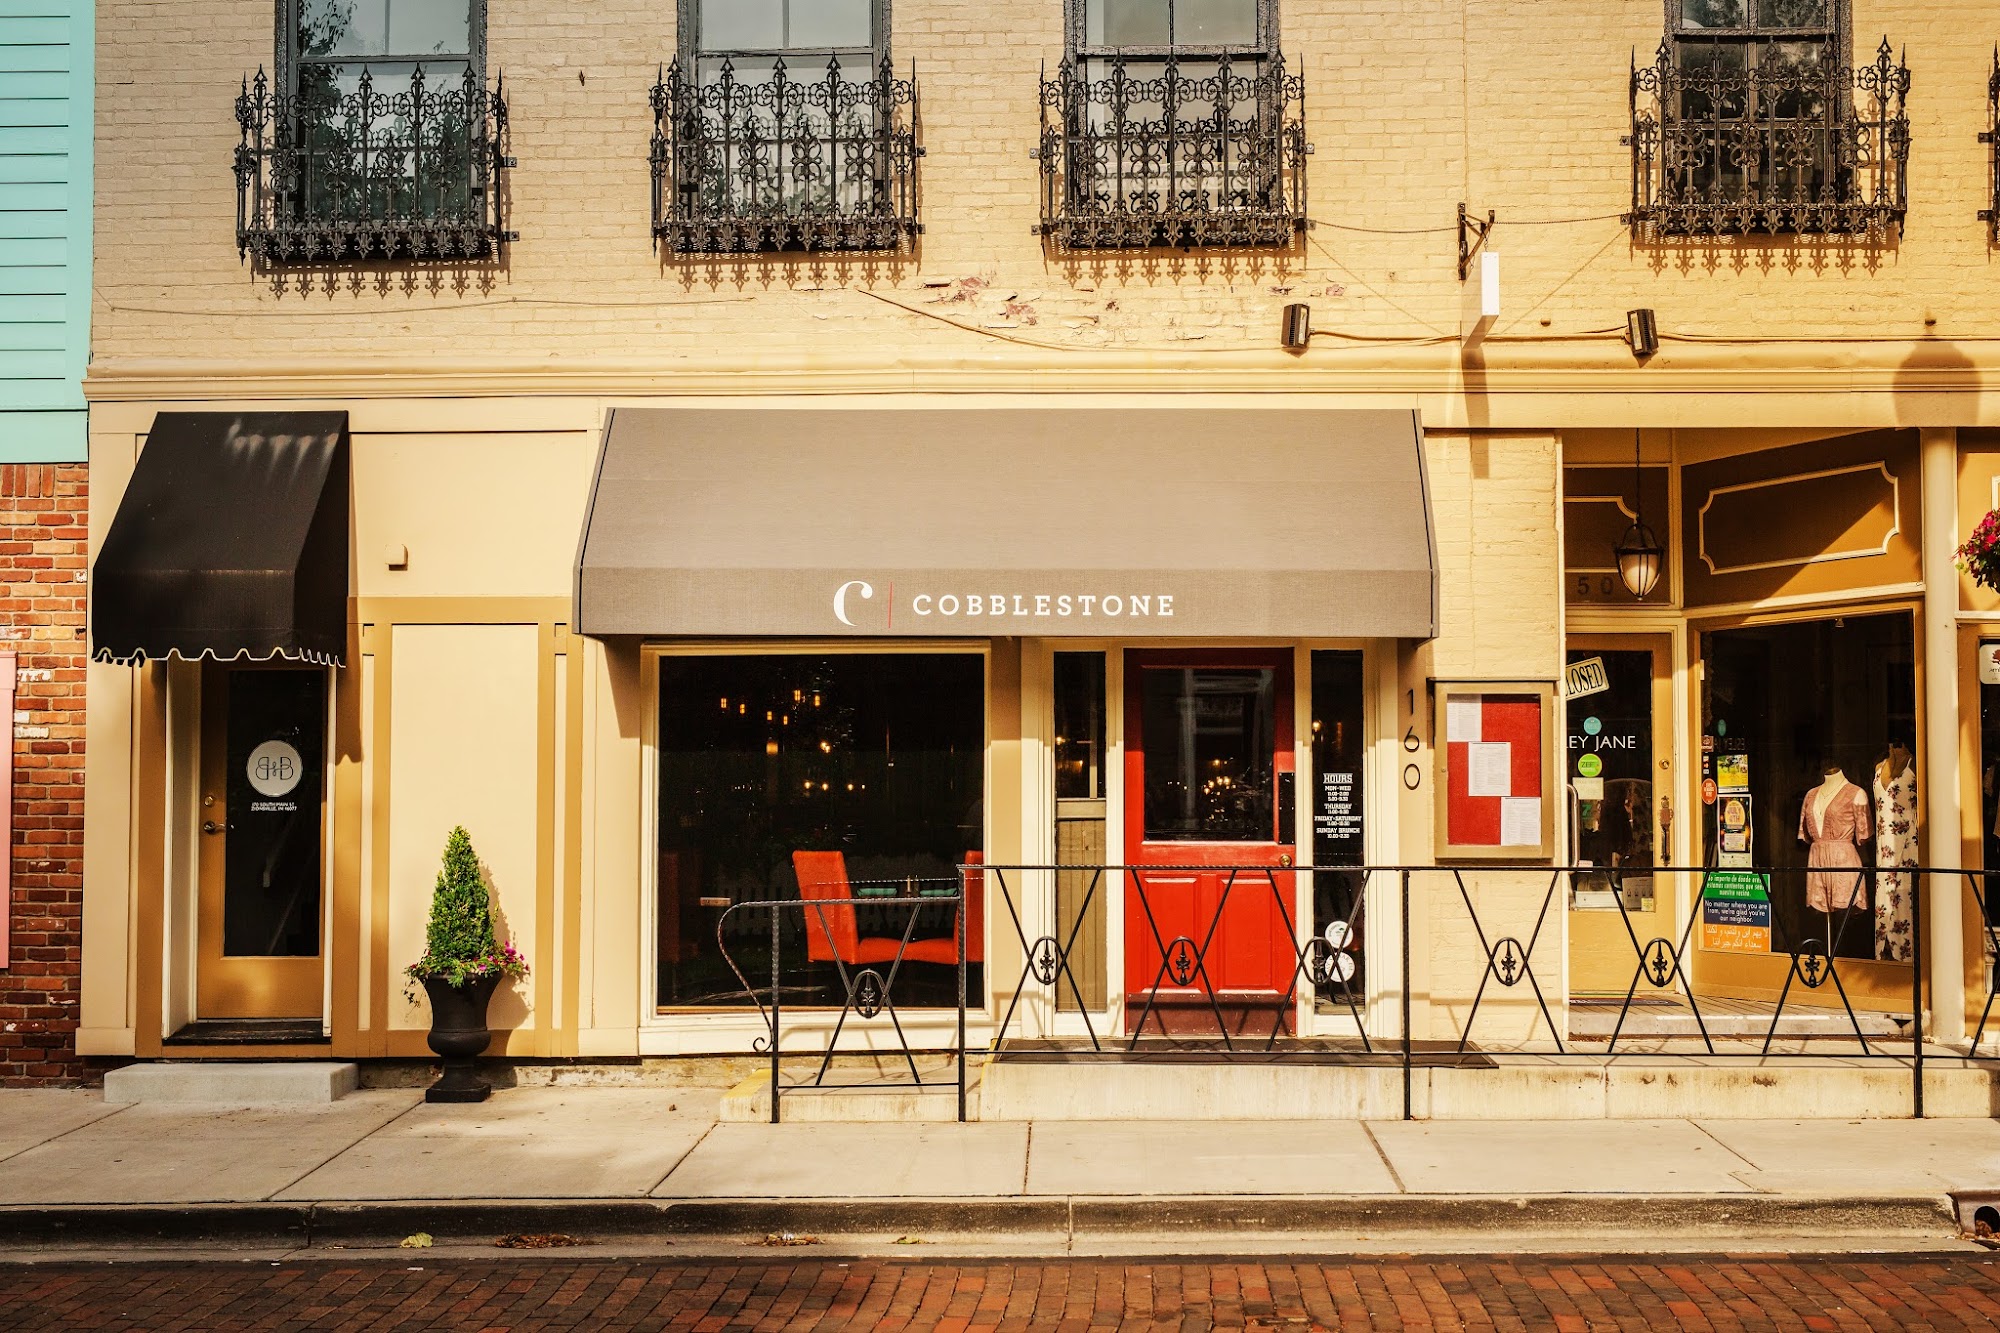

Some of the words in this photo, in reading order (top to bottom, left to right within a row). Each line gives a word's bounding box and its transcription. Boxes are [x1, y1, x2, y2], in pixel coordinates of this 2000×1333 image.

[912, 594, 1174, 616] COBBLESTONE
[1565, 662, 1604, 696] LOSED
[1404, 688, 1420, 790] 160
[1566, 735, 1588, 749] EY
[1594, 735, 1636, 752] JANE
[1323, 773, 1353, 784] HOURS
[1705, 899, 1712, 907] No
[1731, 901, 1747, 909] where
[1748, 903, 1757, 911] you
[1707, 906, 1720, 914] from,
[1736, 908, 1747, 917] glad
[1748, 910, 1765, 918] you're
[1729, 916, 1754, 924] neighbor.
